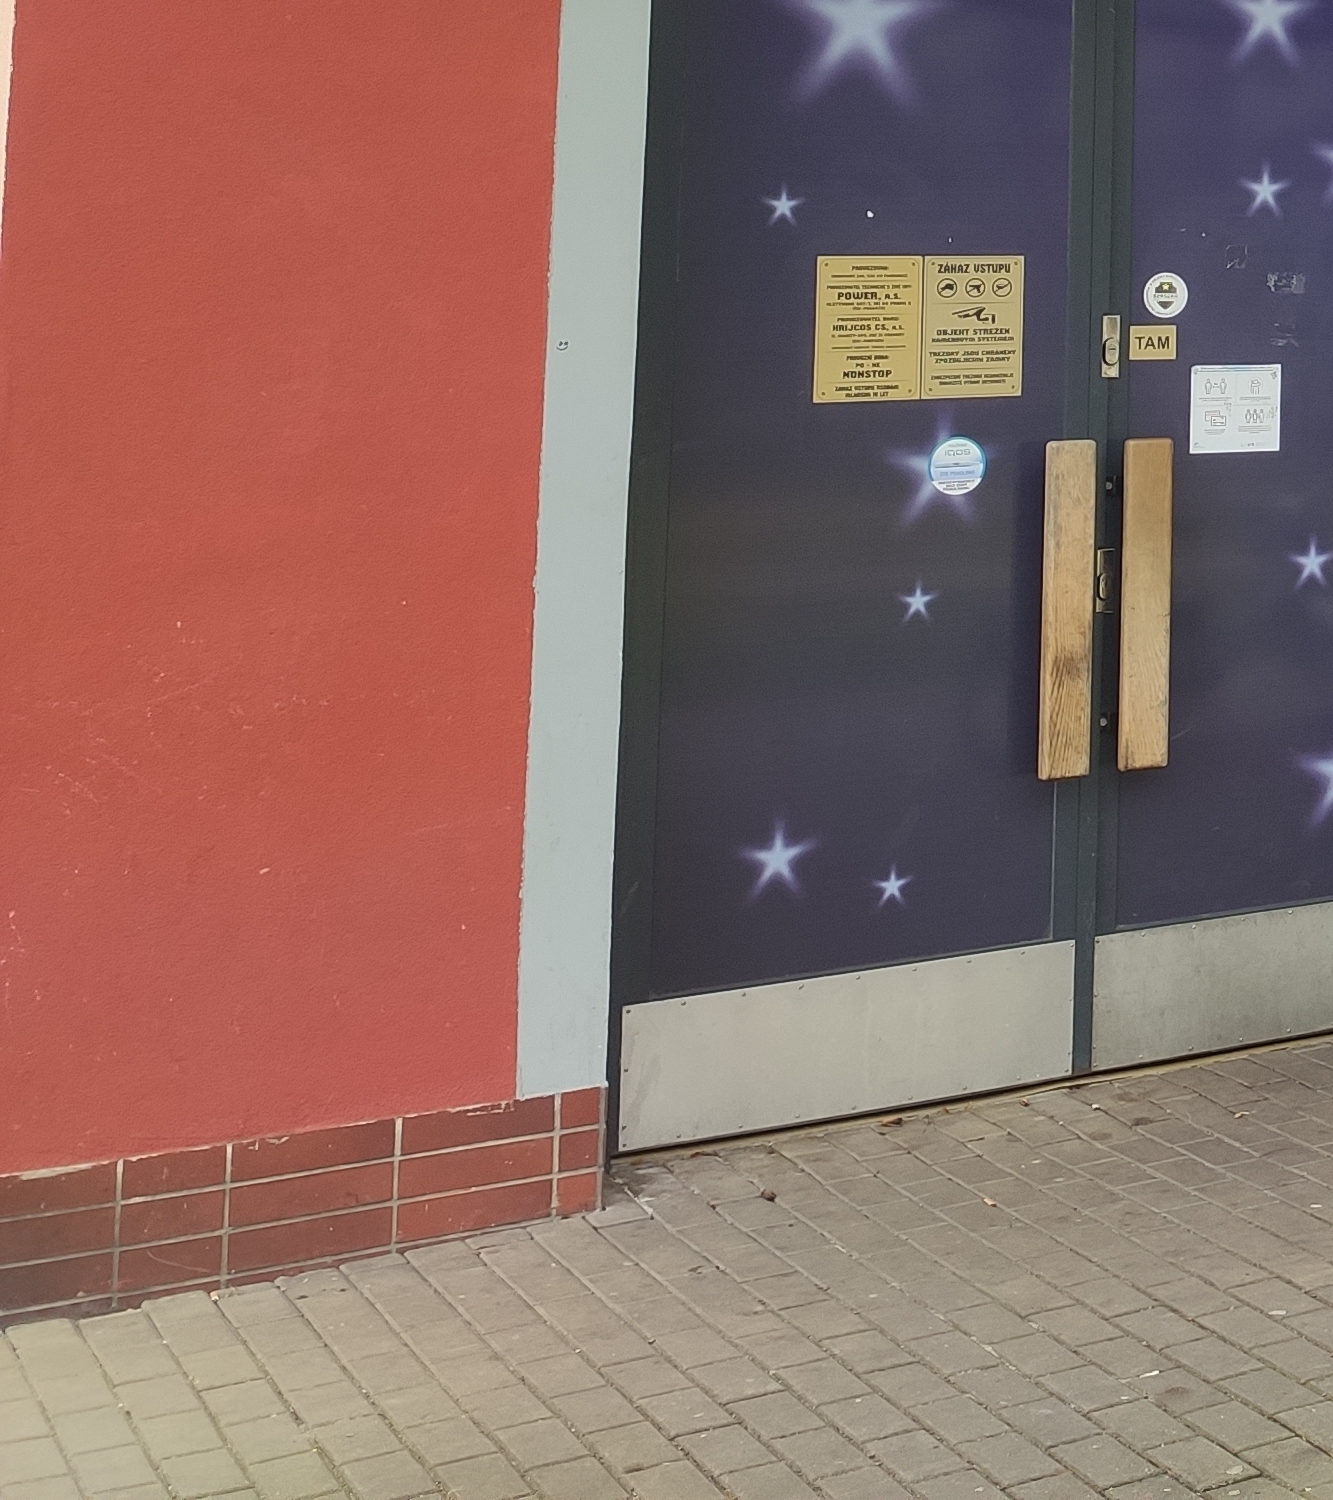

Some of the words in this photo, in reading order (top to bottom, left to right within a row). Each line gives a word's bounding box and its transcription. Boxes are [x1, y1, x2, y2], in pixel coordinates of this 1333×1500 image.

[973, 263, 1011, 274] VSTUPU
[1134, 336, 1170, 350] TAM
[842, 369, 893, 379] NONSTOP
[944, 448, 971, 457] IQOS
